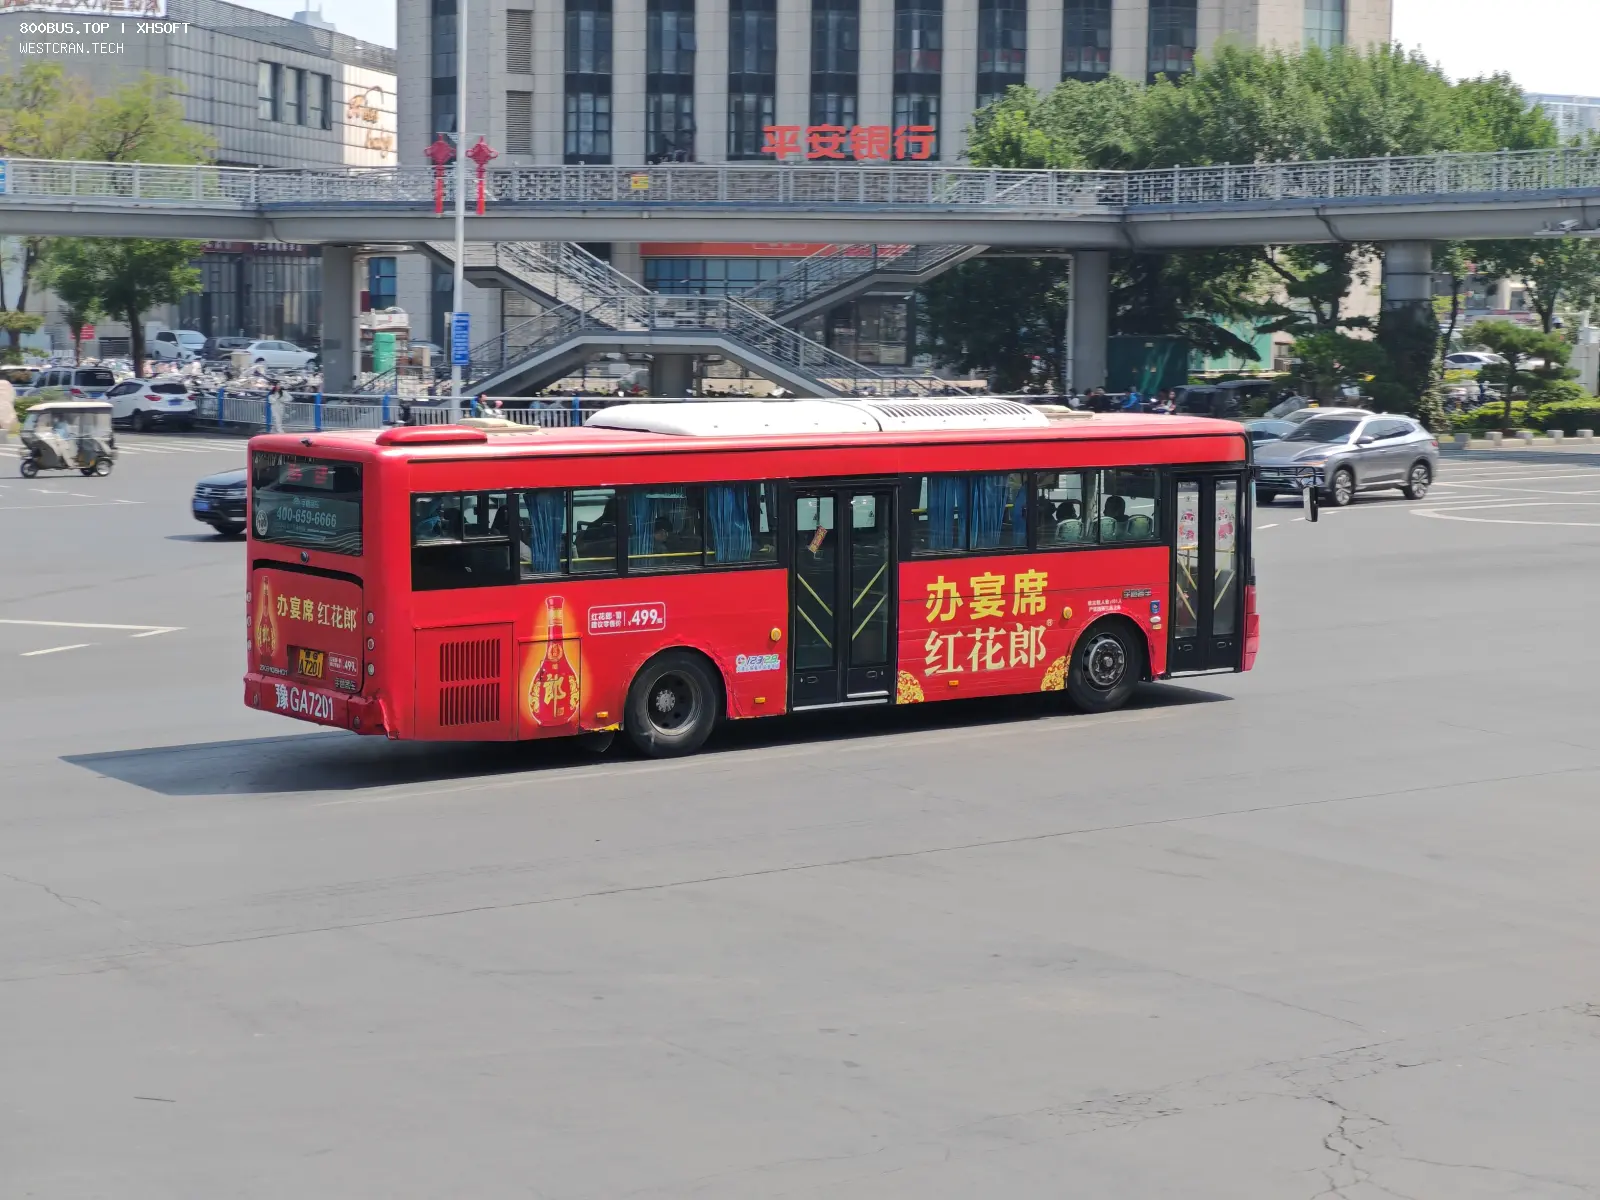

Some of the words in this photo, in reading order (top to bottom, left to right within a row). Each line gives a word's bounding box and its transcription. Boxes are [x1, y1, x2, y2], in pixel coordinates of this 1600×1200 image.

[760, 123, 936, 160] 平安银行
[276, 506, 337, 528] 400-659-6666
[277, 593, 314, 622] 办宴席
[317, 601, 357, 632] 红花郎
[926, 568, 1049, 623] 办宴席
[298, 658, 323, 679] A7201
[924, 622, 1048, 677] 红花郎
[274, 682, 335, 721] 豫GA7201
